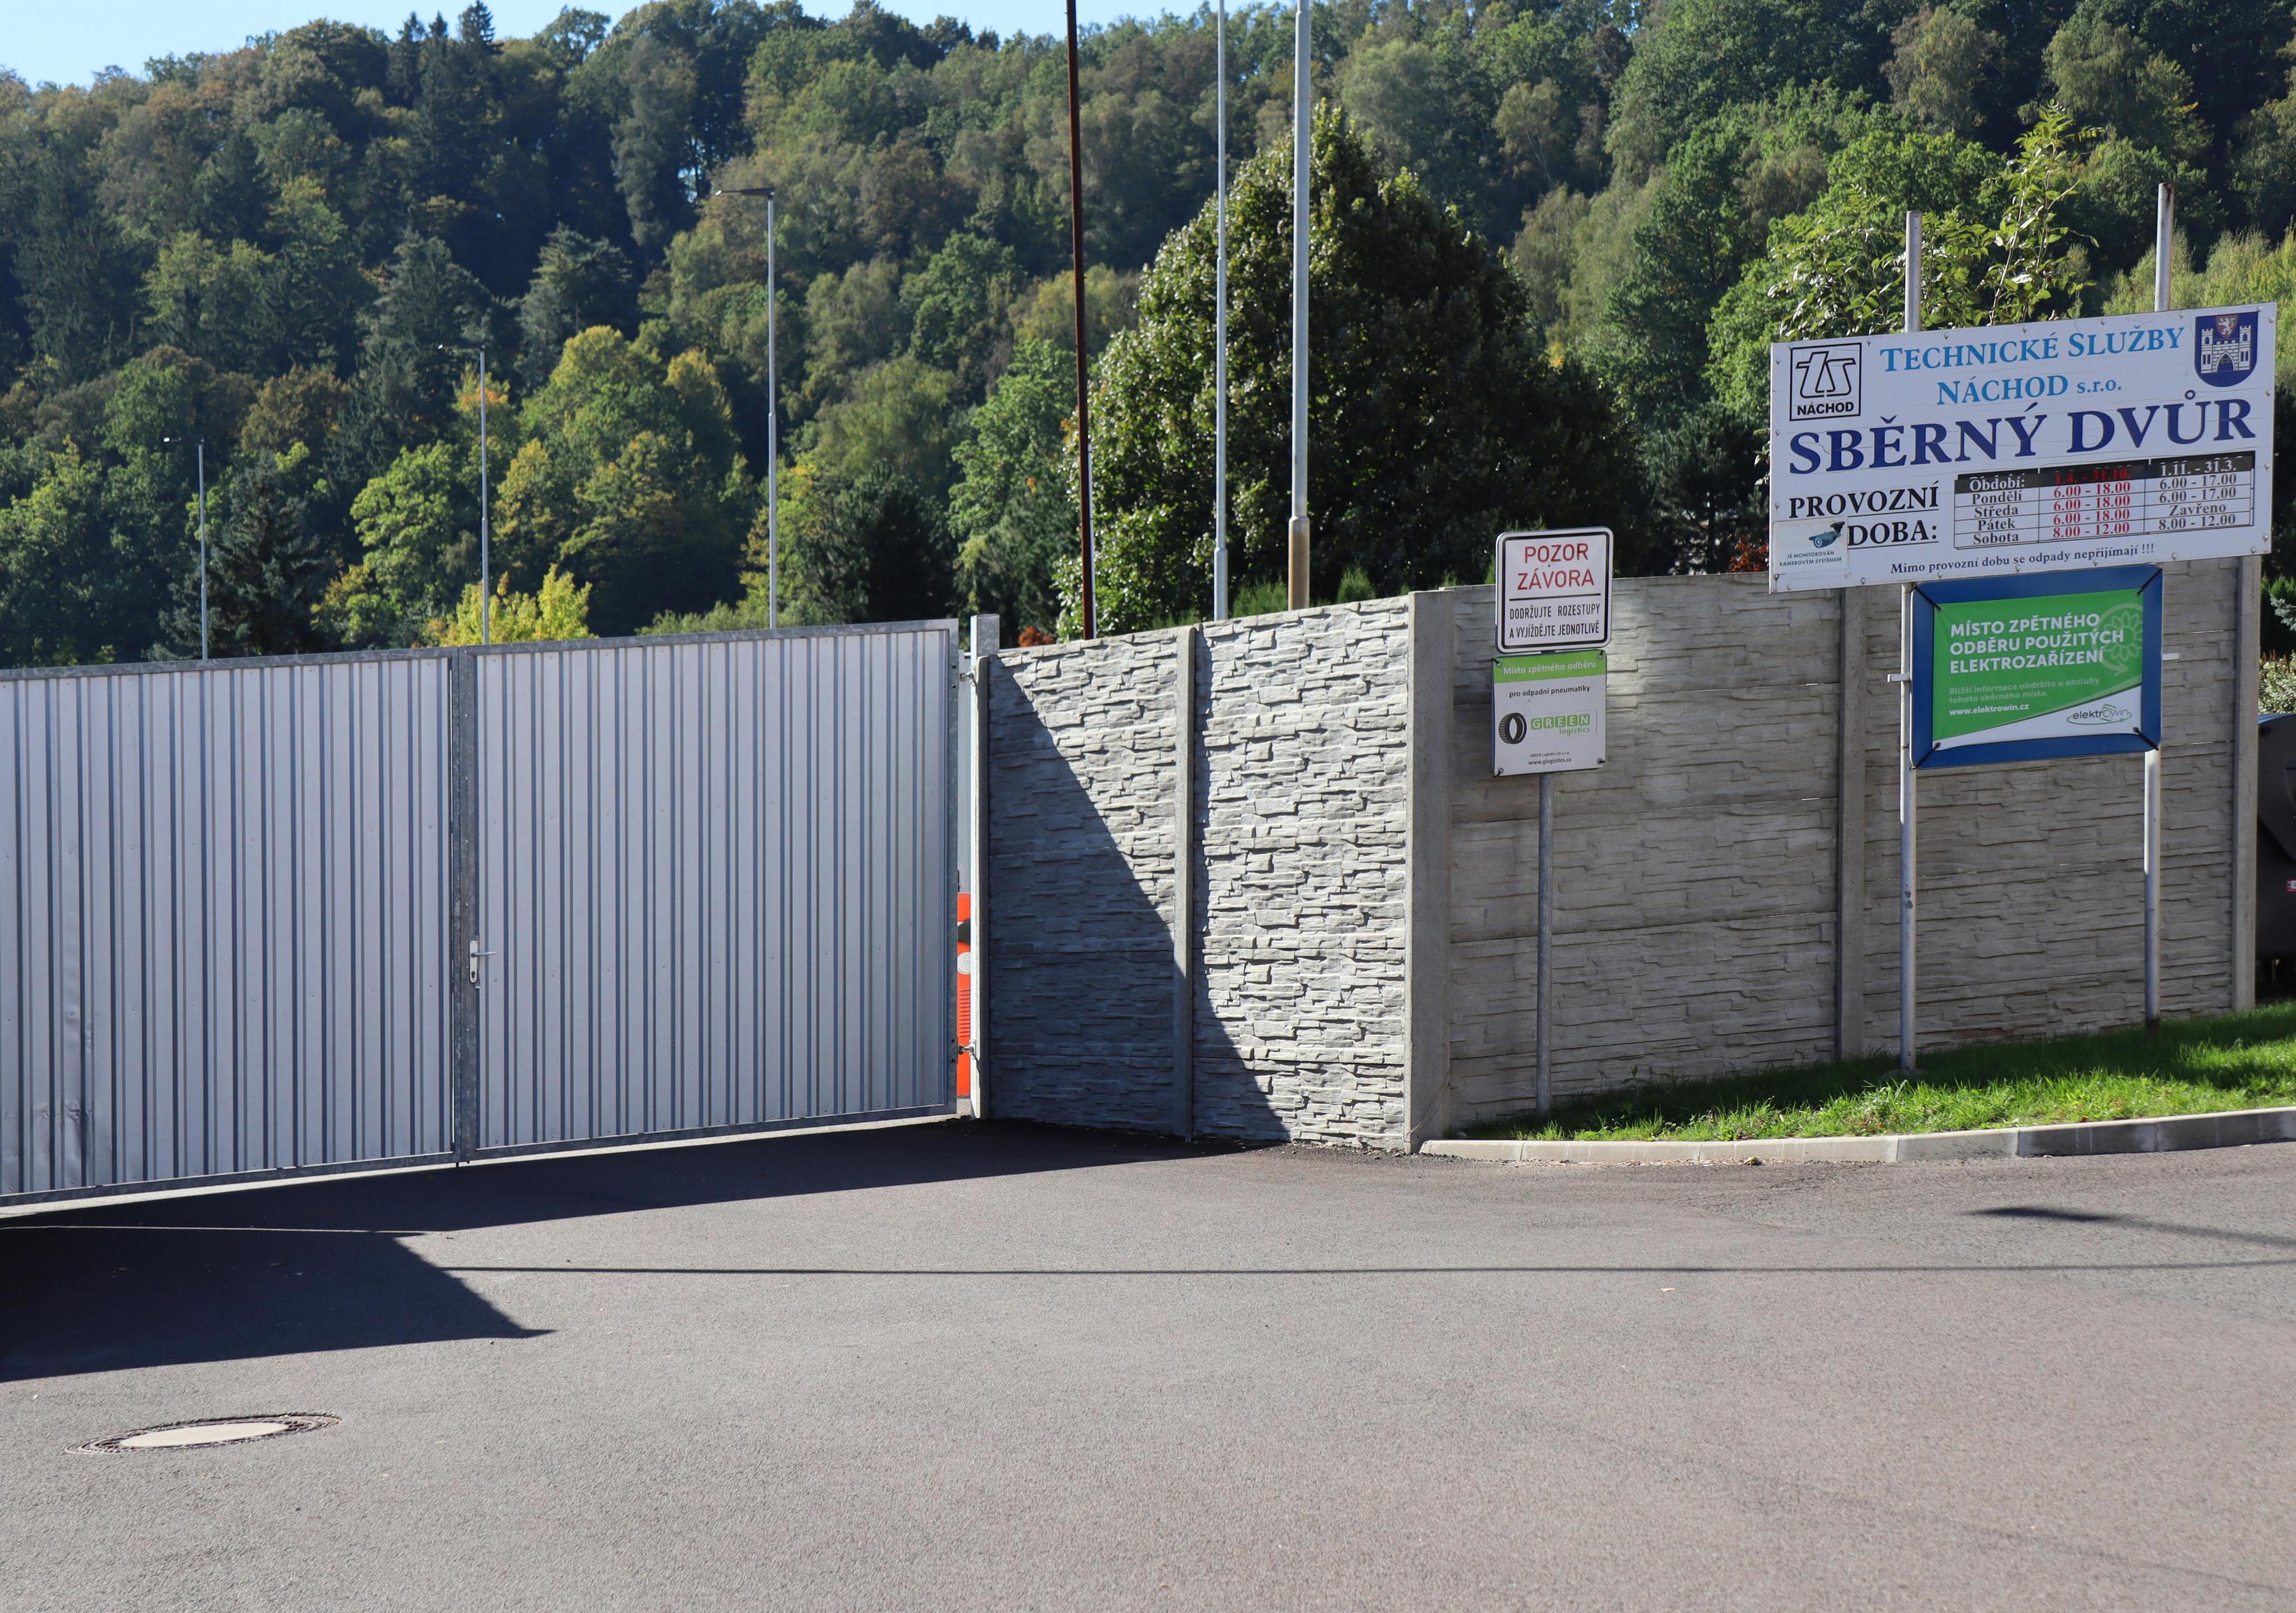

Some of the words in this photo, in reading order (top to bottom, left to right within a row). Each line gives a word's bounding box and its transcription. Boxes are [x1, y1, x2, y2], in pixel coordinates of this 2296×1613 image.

[1880, 332, 2060, 372] TECHNICKÉ
[2068, 325, 2185, 357] SLUŽBY
[1937, 375, 2068, 405] NÁCHOD
[2077, 379, 2122, 394] s.r.o.
[1797, 402, 1854, 416] NÁCHOD
[1789, 402, 2047, 474] SBĚRNÝ
[2066, 390, 2256, 453] DVŮR
[1969, 475, 2025, 491] Období:
[2161, 462, 2191, 476] 1.11.
[2204, 460, 2236, 473] 31.3.
[1789, 480, 1939, 518] PROVOZNÍ
[1972, 490, 2022, 505] Pondělí
[2054, 485, 2081, 498] 6.00
[2096, 481, 2130, 495] 18.00
[2159, 477, 2187, 490] 6.00
[2202, 473, 2236, 486] 17.00
[1974, 504, 2018, 518] Středa
[2053, 499, 2081, 511] 6.00
[2096, 495, 2130, 508] 18.00
[2159, 490, 2186, 503] 6.00
[2202, 487, 2236, 500] 17.00
[1973, 533, 2019, 545] Sobota
[2053, 526, 2080, 538] 8.00
[2096, 522, 2130, 535] 12.00
[2159, 517, 2186, 530] 8.00
[2201, 514, 2235, 527] 12.00
[1977, 518, 2015, 532] Pátek
[2053, 512, 2080, 525] 6.00
[2096, 509, 2130, 522] 18.00
[2169, 503, 2227, 516] Zavřeno
[1848, 520, 1937, 546] DOBA:
[1525, 543, 1589, 564] POZOR
[1891, 563, 1925, 574] Mimo
[1929, 557, 1979, 573] provozní
[1981, 556, 2010, 567] dobu
[2013, 556, 2025, 564] se
[2029, 551, 2070, 564] odpady
[2074, 544, 2139, 561] nepřijímají
[2142, 543, 2154, 553] !!!
[1517, 568, 1595, 591] ZÁVORA
[1510, 604, 1552, 619] DODRŽUJTE
[1558, 603, 1600, 617] ROZESTUPY
[1510, 627, 1514, 638] A
[1517, 623, 1556, 638] VYJÍŽDĚJTE
[1558, 620, 1600, 635] JEDNOTLIVĚ
[1950, 620, 2004, 637] MÍSTO
[2008, 612, 2099, 633] ZPĚTNÉHO
[1950, 637, 2020, 656] ODBĚRU
[2024, 629, 2124, 650] POUŽITÝCH
[1503, 666, 1526, 675] Místo
[1528, 662, 1565, 674] zpětného
[1568, 661, 1596, 670] odběru
[1950, 646, 2104, 674] ELEKTROZAŘÍZENÍ
[1522, 688, 1549, 697] odpadní
[1551, 685, 1591, 695] pneumatiky
[1949, 686, 1972, 695] Bližší
[1975, 684, 2018, 693] informace
[2019, 681, 2056, 689] obdržíte
[2066, 677, 2100, 686] obsluhy
[1949, 695, 1979, 704] tohoto
[1980, 692, 2020, 701] sběrného
[2022, 690, 2048, 698] místa.
[1532, 715, 1589, 728] GREEN
[1949, 704, 2030, 716] www.elektrowin.cz
[1559, 727, 1590, 736] logistics
